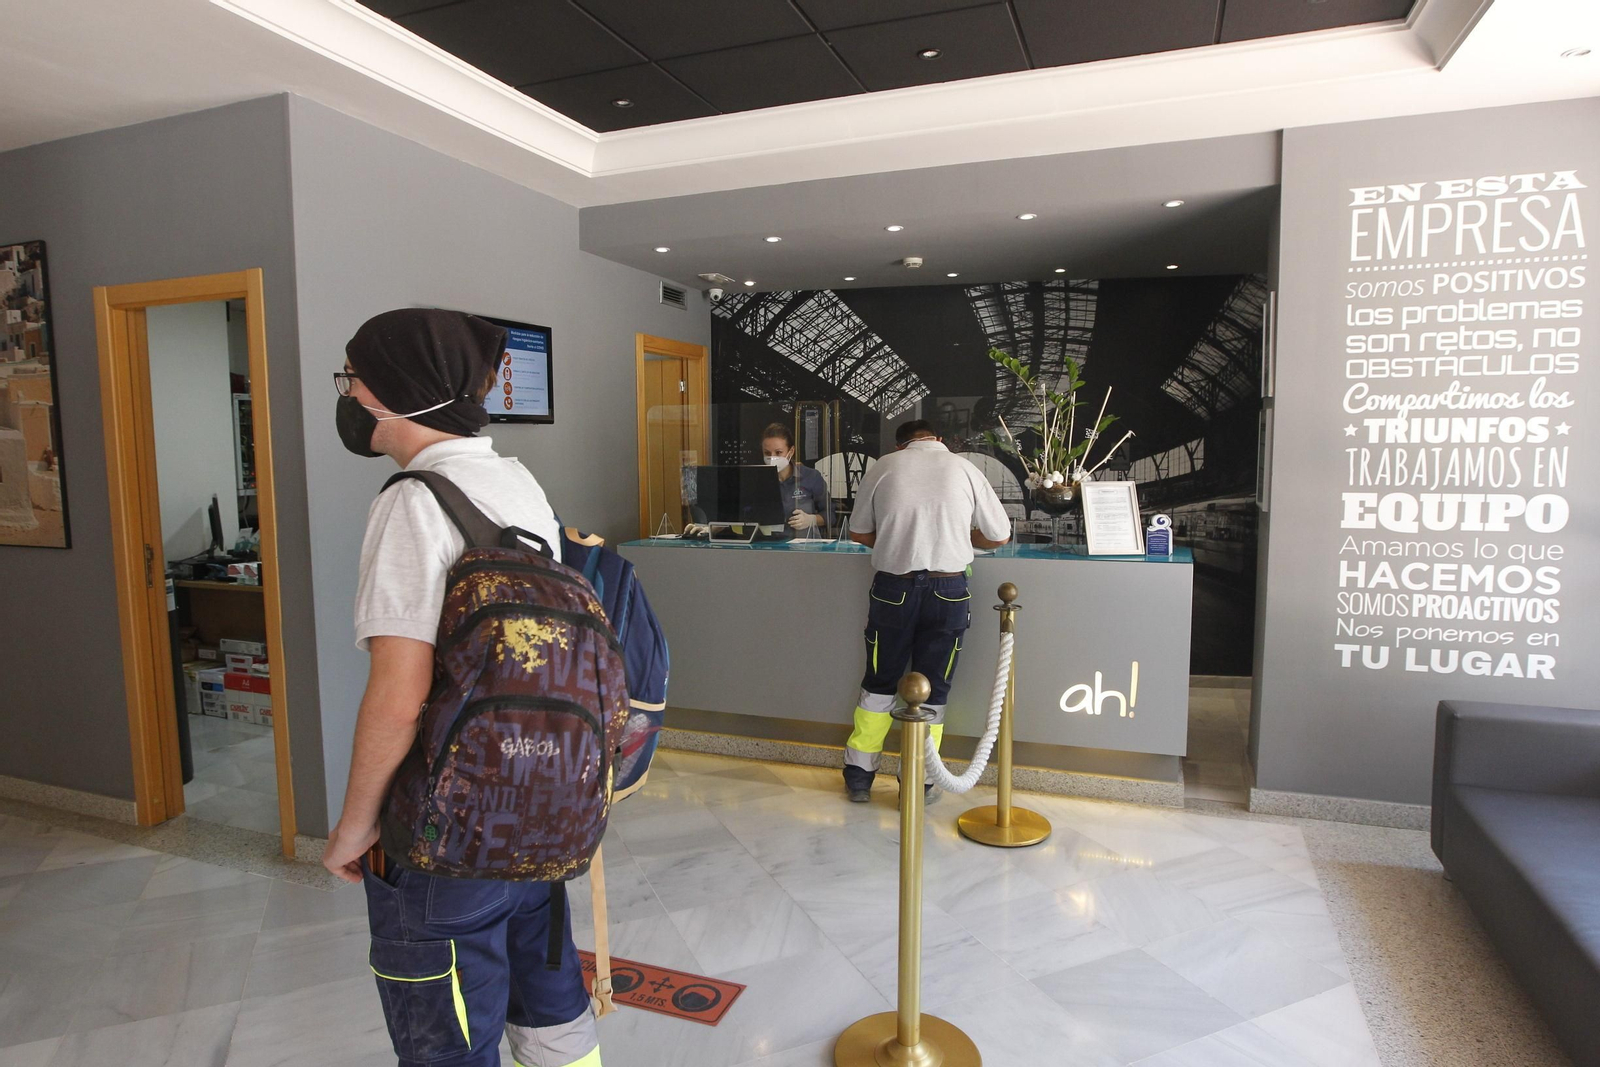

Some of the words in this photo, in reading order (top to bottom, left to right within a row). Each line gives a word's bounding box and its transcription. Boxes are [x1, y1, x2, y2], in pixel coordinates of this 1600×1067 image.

[1348, 182, 1427, 206] EN
[1434, 170, 1588, 199] ESTA
[1350, 193, 1586, 262] EMPRESA
[1345, 278, 1425, 298] somos
[1433, 266, 1586, 294] POSITIVOS
[1346, 304, 1393, 326] los
[1401, 298, 1583, 330] problemas
[1346, 333, 1410, 353] son
[1419, 325, 1523, 352] retos,
[1532, 327, 1581, 348] no
[1345, 349, 1580, 379] OBSTÁCULOS
[1343, 380, 1525, 419] Compartimos
[1528, 376, 1575, 409] los
[1364, 416, 1550, 444] TRIUNFOS
[1345, 446, 1522, 491] TRABAJAMOS
[1533, 446, 1569, 488] EN
[1340, 492, 1570, 533] EQUIPO
[1339, 535, 1464, 557] Amamos
[1474, 538, 1498, 559] lo
[1508, 543, 1564, 563] que
[1339, 560, 1561, 595] HACEMOS
[1336, 592, 1409, 617] SOMOS
[1412, 593, 1560, 624] PROACTIVOS
[1336, 618, 1383, 638] Nos
[1395, 625, 1514, 647] ponemos
[1527, 631, 1560, 647] en
[1334, 644, 1389, 670] TU
[1405, 647, 1556, 680] LUGAR
[1060, 661, 1139, 719] ah!
[499, 736, 560, 759] GABOL
